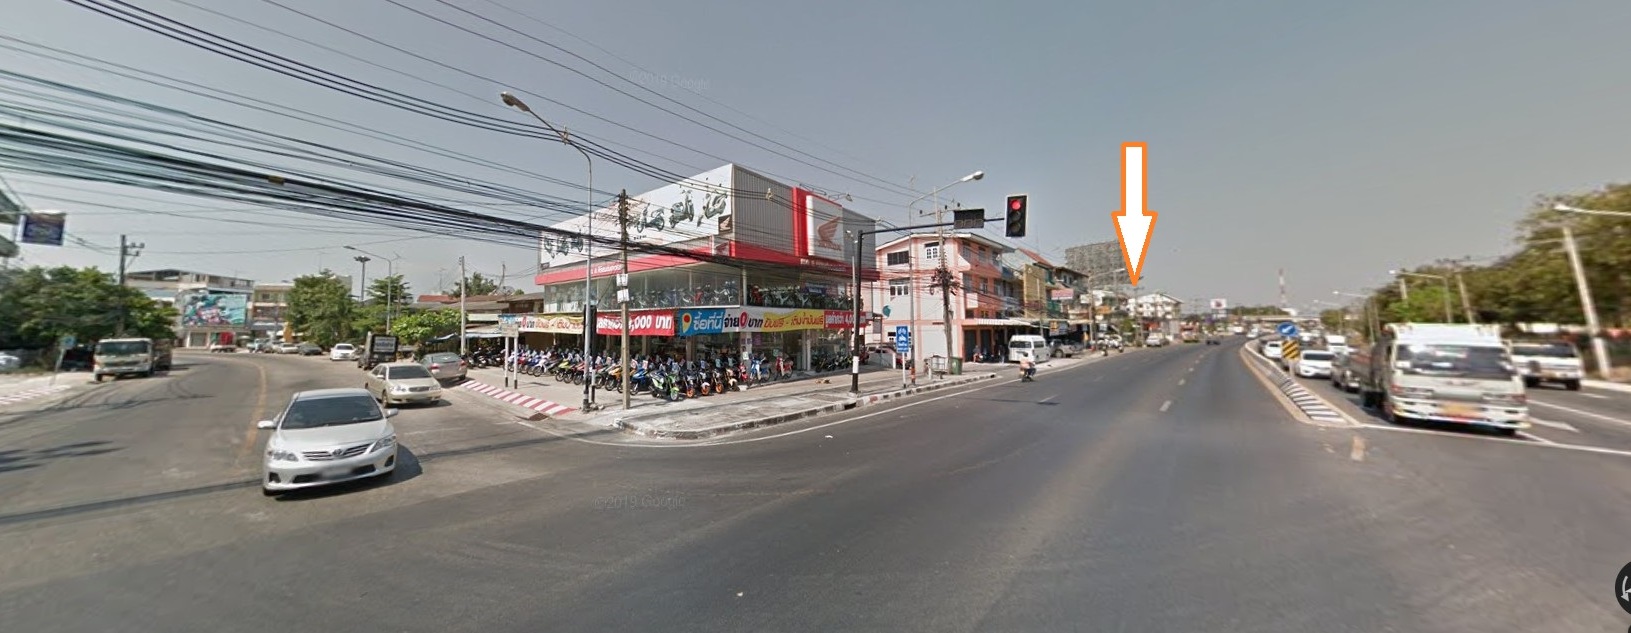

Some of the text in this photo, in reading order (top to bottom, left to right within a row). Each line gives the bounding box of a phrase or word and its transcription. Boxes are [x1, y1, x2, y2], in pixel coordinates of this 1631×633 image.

[655, 315, 673, 329] บาท
[693, 311, 724, 331] ซื้อที่นี่
